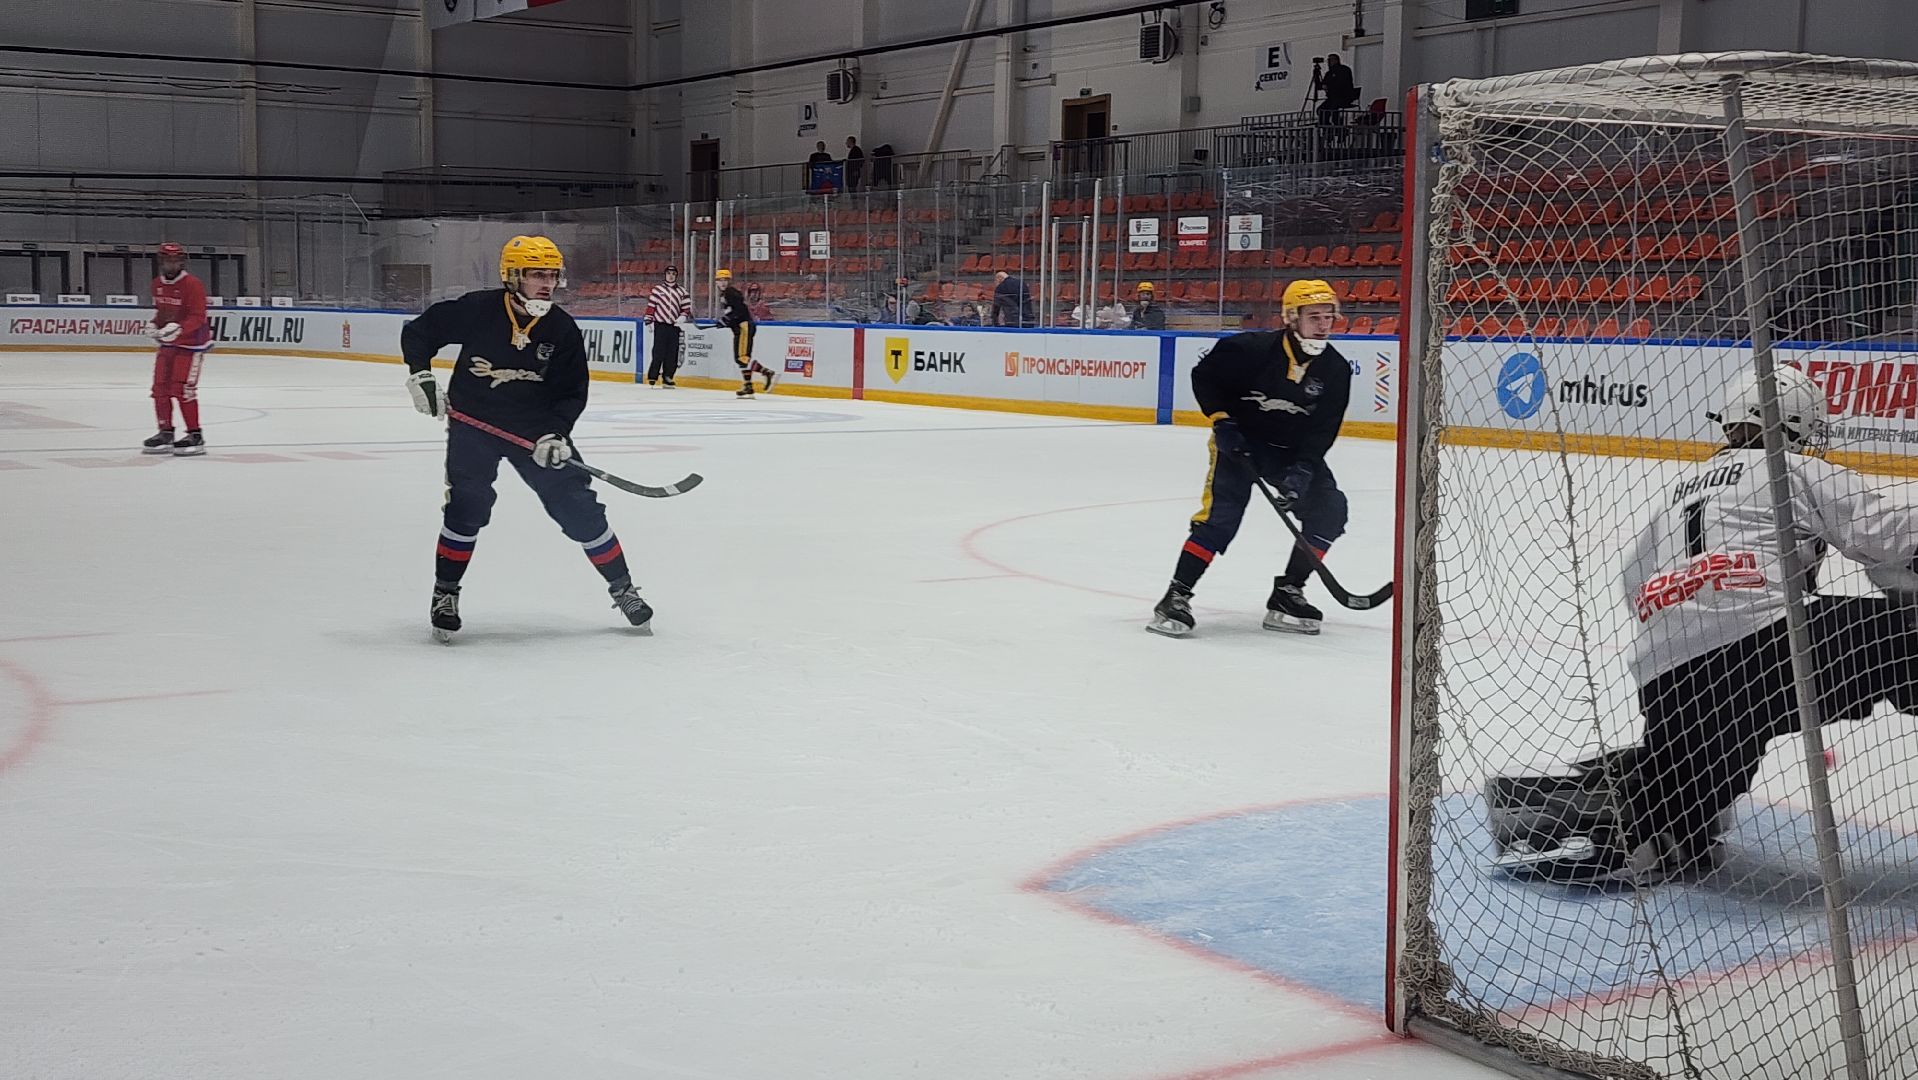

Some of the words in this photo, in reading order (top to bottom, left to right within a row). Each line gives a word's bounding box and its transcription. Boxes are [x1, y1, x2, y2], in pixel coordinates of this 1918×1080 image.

[1259, 71, 1288, 82] СЕКТОР
[804, 104, 812, 120] D
[9, 318, 89, 335] КРАСНАЯ
[92, 319, 147, 335] МАШИН
[208, 316, 305, 343] HL.KHL.RU
[913, 351, 966, 373] БАНК
[1022, 357, 1147, 379] ПРОМСЫРЬЕИМПОРТ
[1679, 494, 1711, 559] 1
